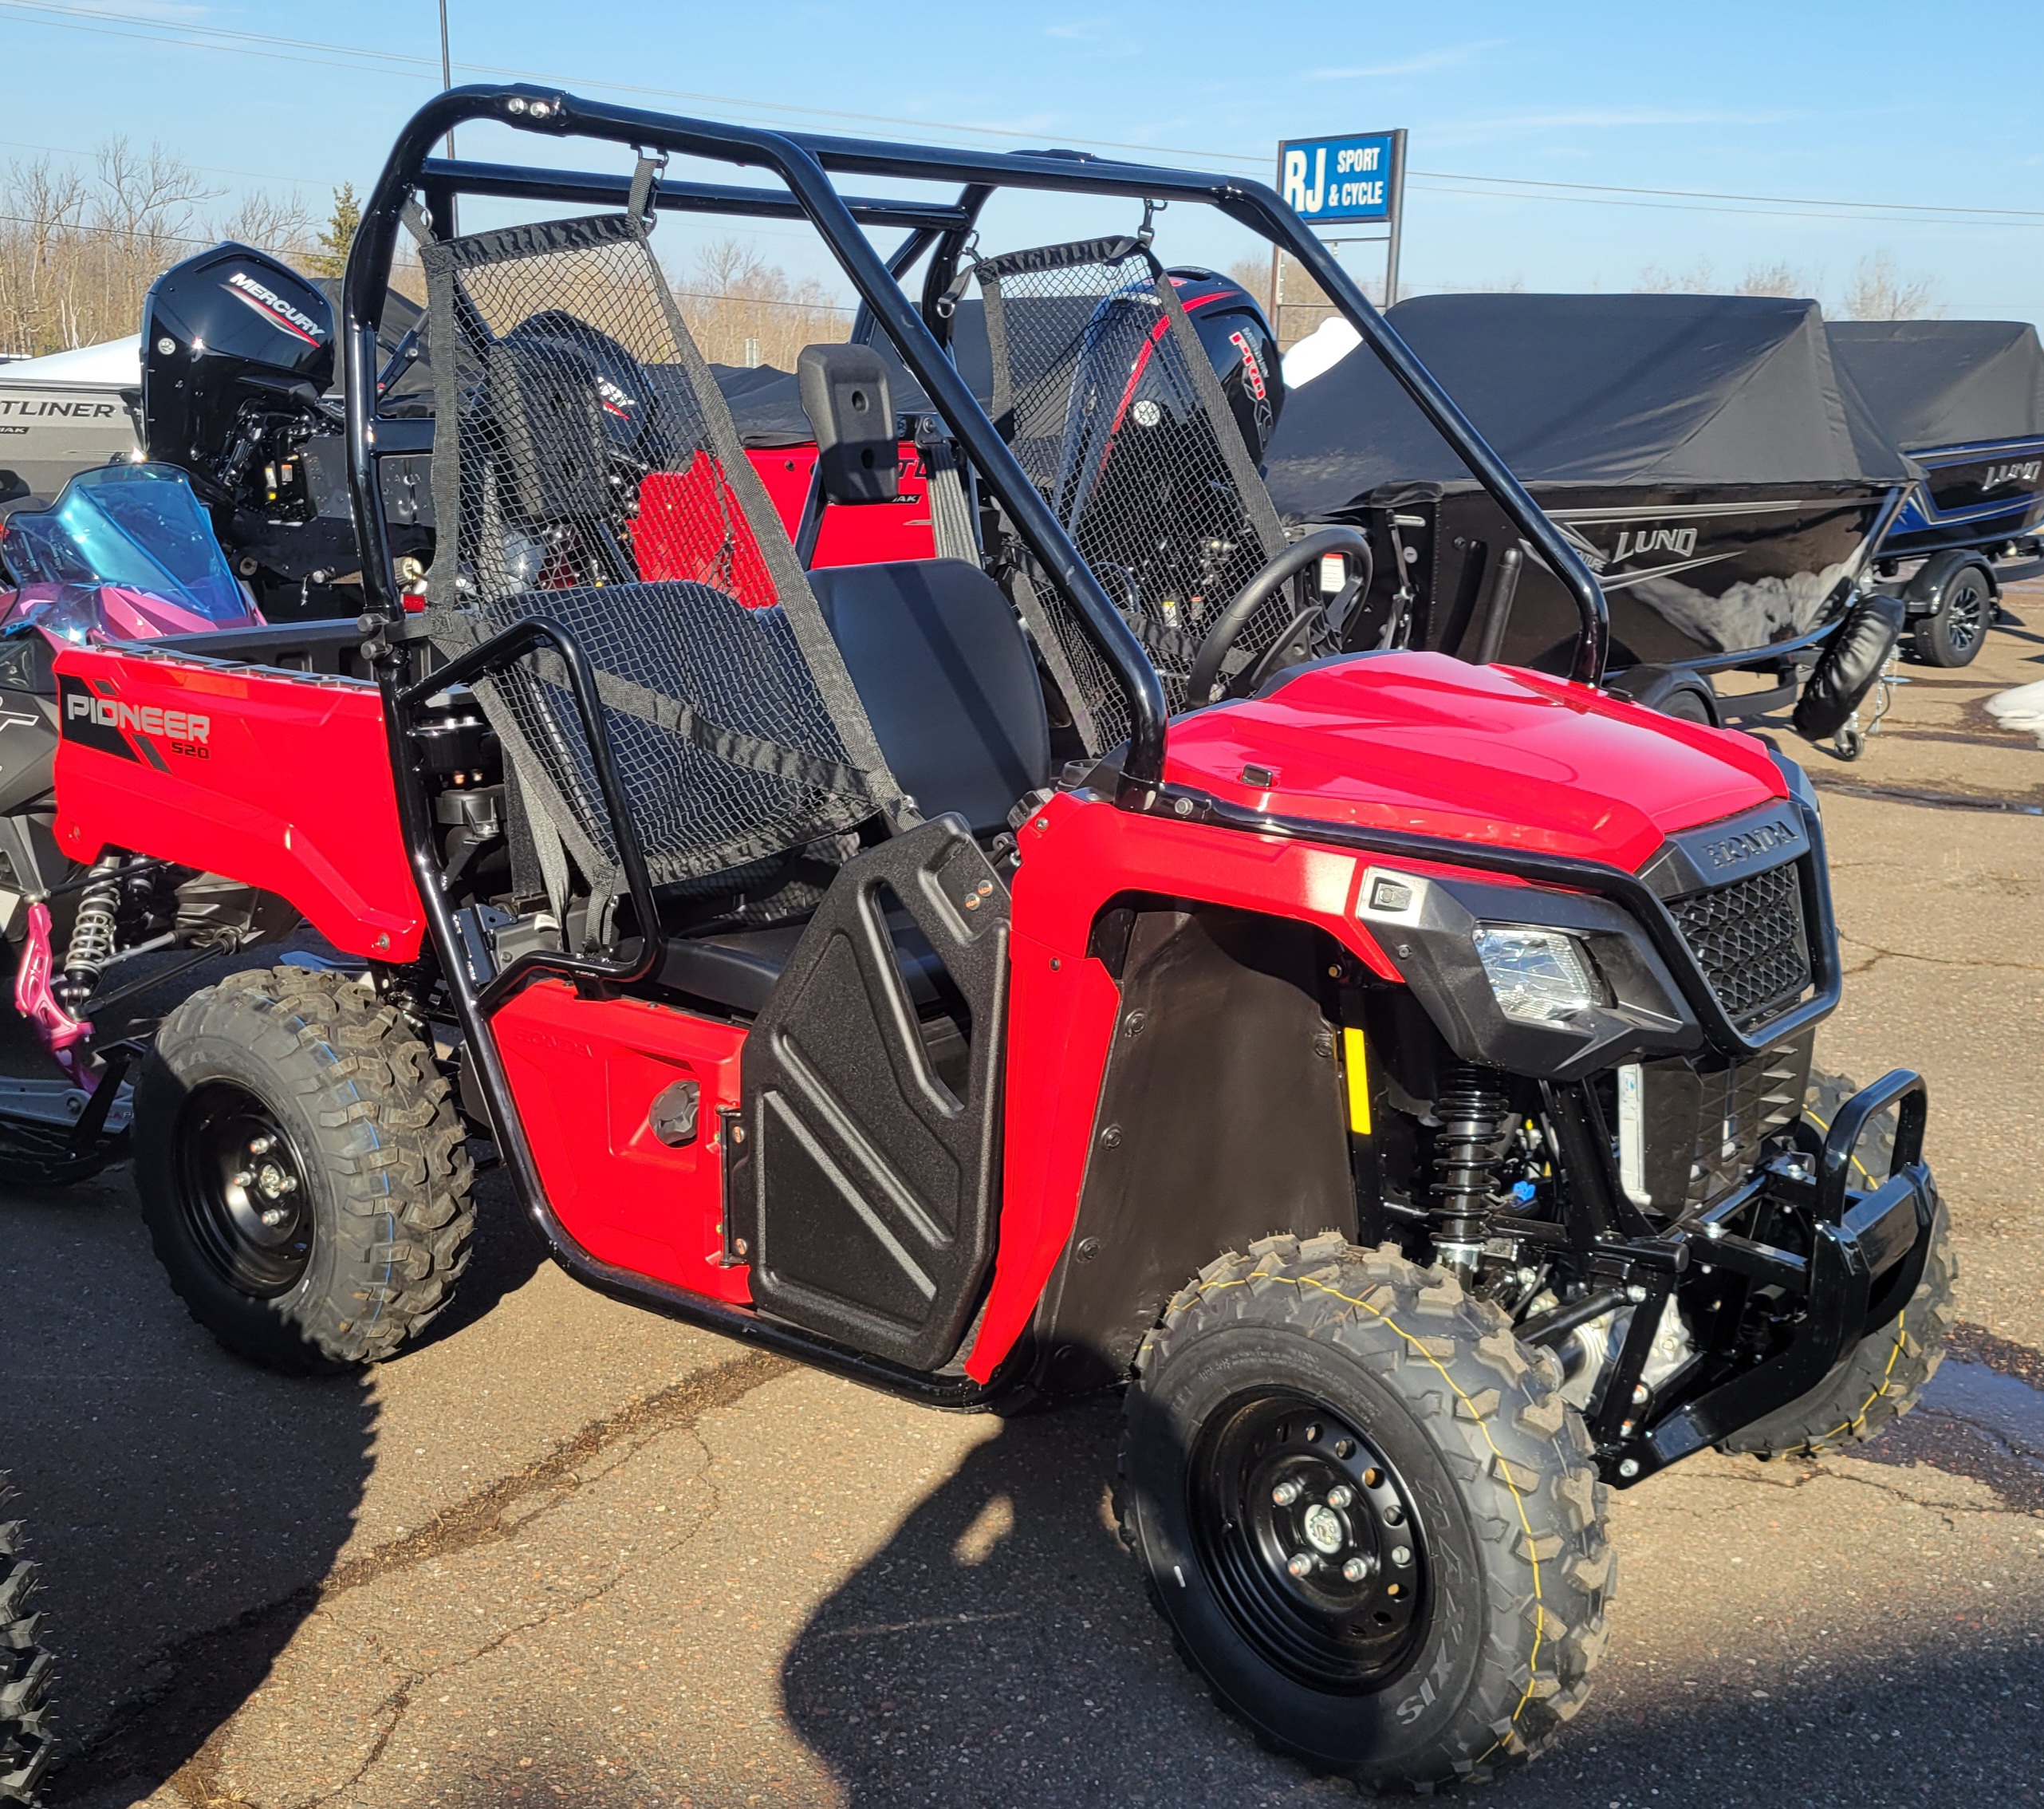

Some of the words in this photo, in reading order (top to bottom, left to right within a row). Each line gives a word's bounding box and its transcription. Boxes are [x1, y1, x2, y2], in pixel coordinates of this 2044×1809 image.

[1284, 148, 1327, 213] RJ
[1337, 147, 1380, 174] SPORT
[1329, 183, 1340, 207] &
[1341, 180, 1384, 207] CYCLE
[229, 272, 326, 336] MERCURY
[1229, 331, 1266, 401] PRO
[0, 400, 116, 419] TLINER
[1612, 527, 1698, 563] LUND
[67, 693, 211, 745] PIONEER
[171, 740, 211, 759] 520
[1702, 820, 1799, 869] HONDA
